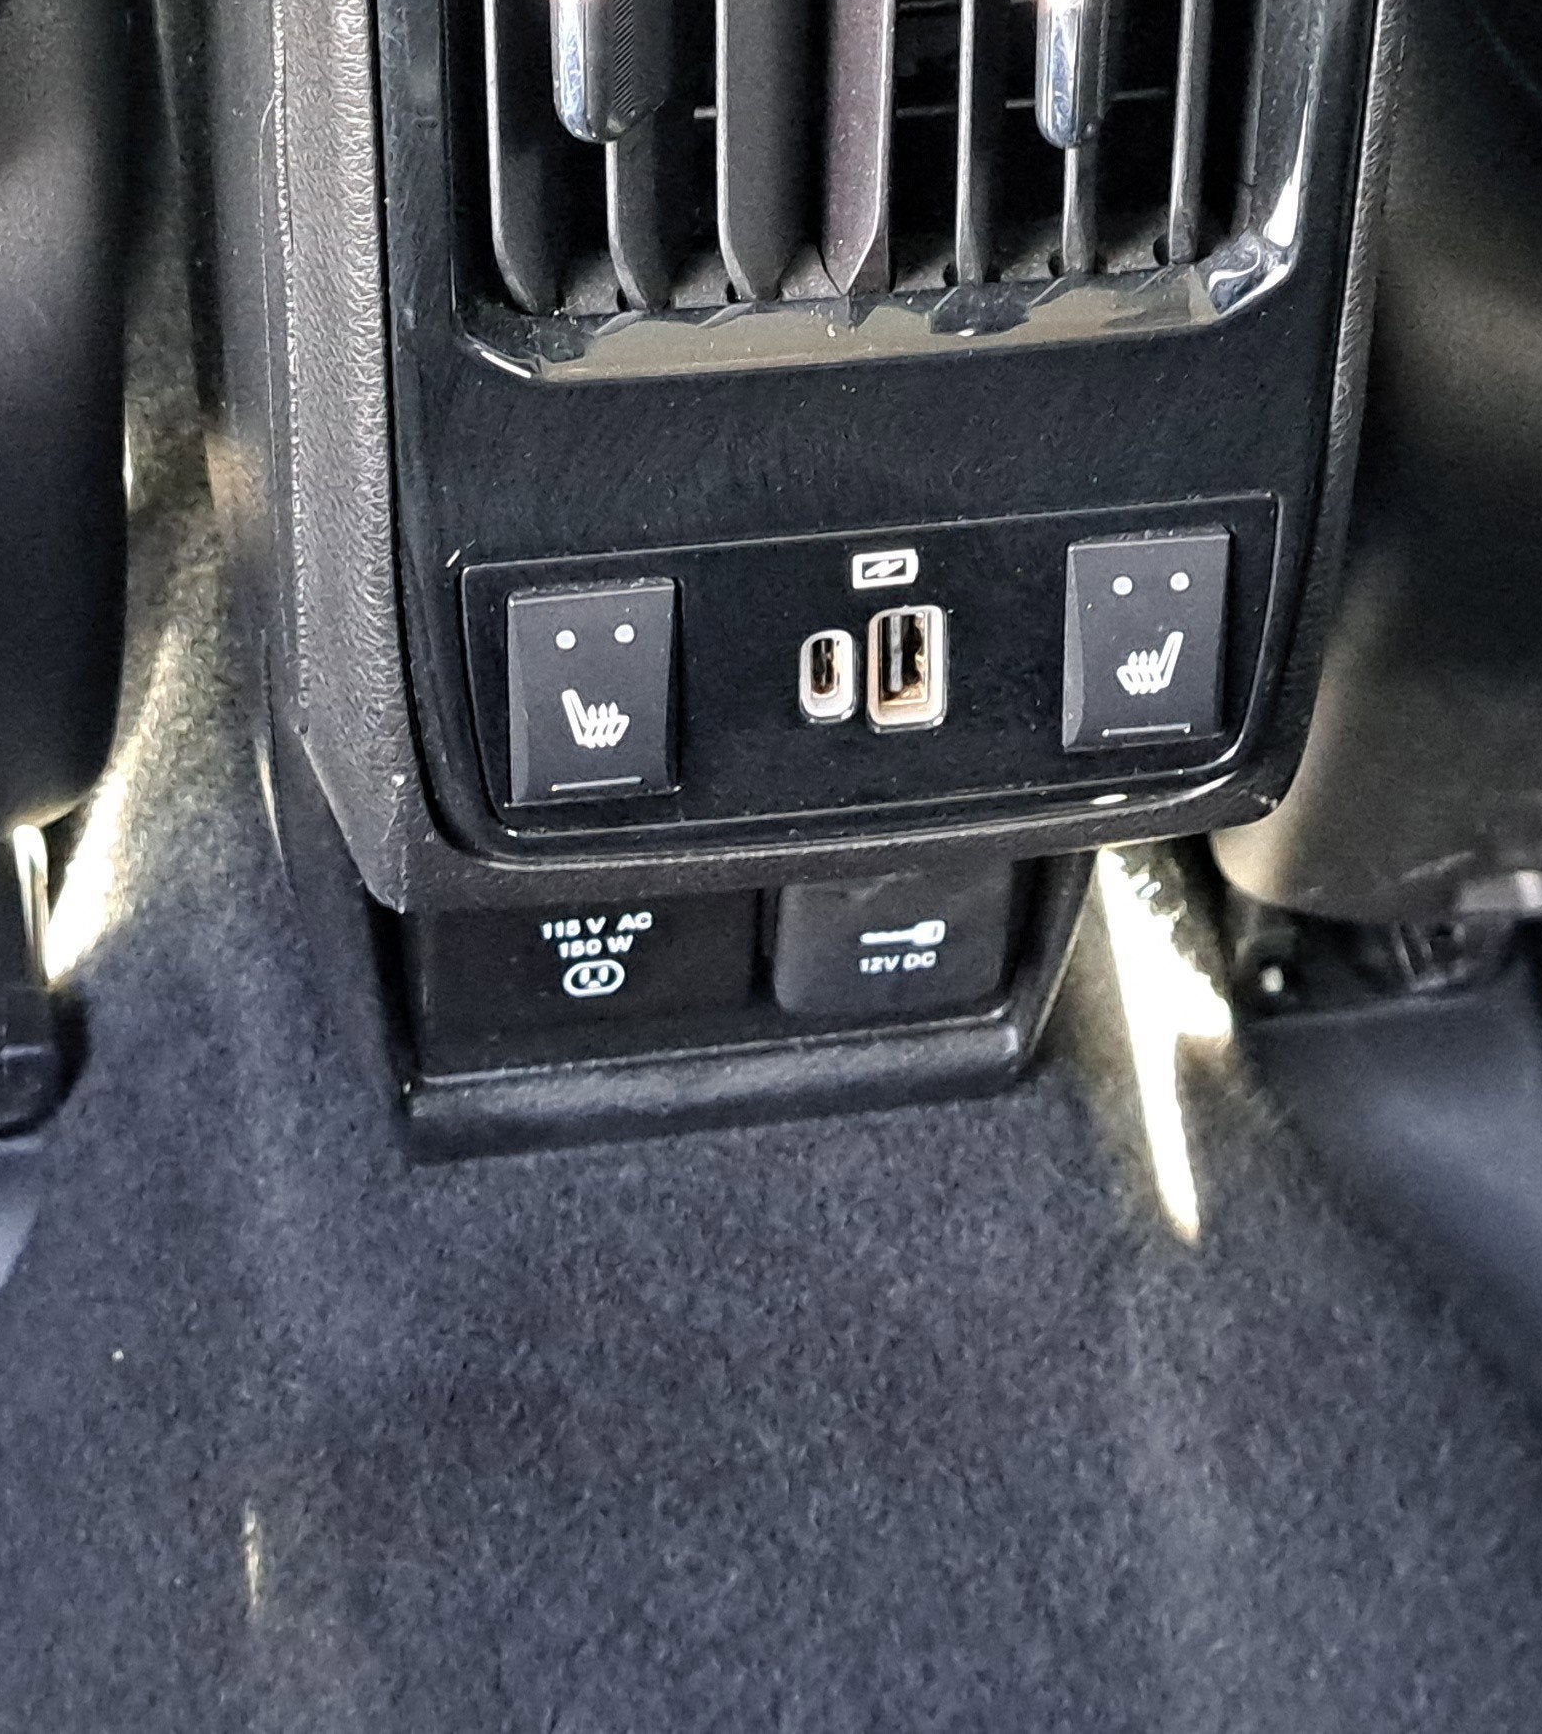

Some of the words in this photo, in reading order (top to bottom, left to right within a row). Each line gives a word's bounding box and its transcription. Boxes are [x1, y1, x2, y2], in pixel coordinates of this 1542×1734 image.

[541, 918, 581, 940] 115
[585, 916, 607, 934] V
[616, 911, 653, 932] AC
[558, 938, 603, 959] 150
[605, 934, 634, 953] W
[859, 954, 901, 974] 12V
[902, 950, 937, 972] DC
